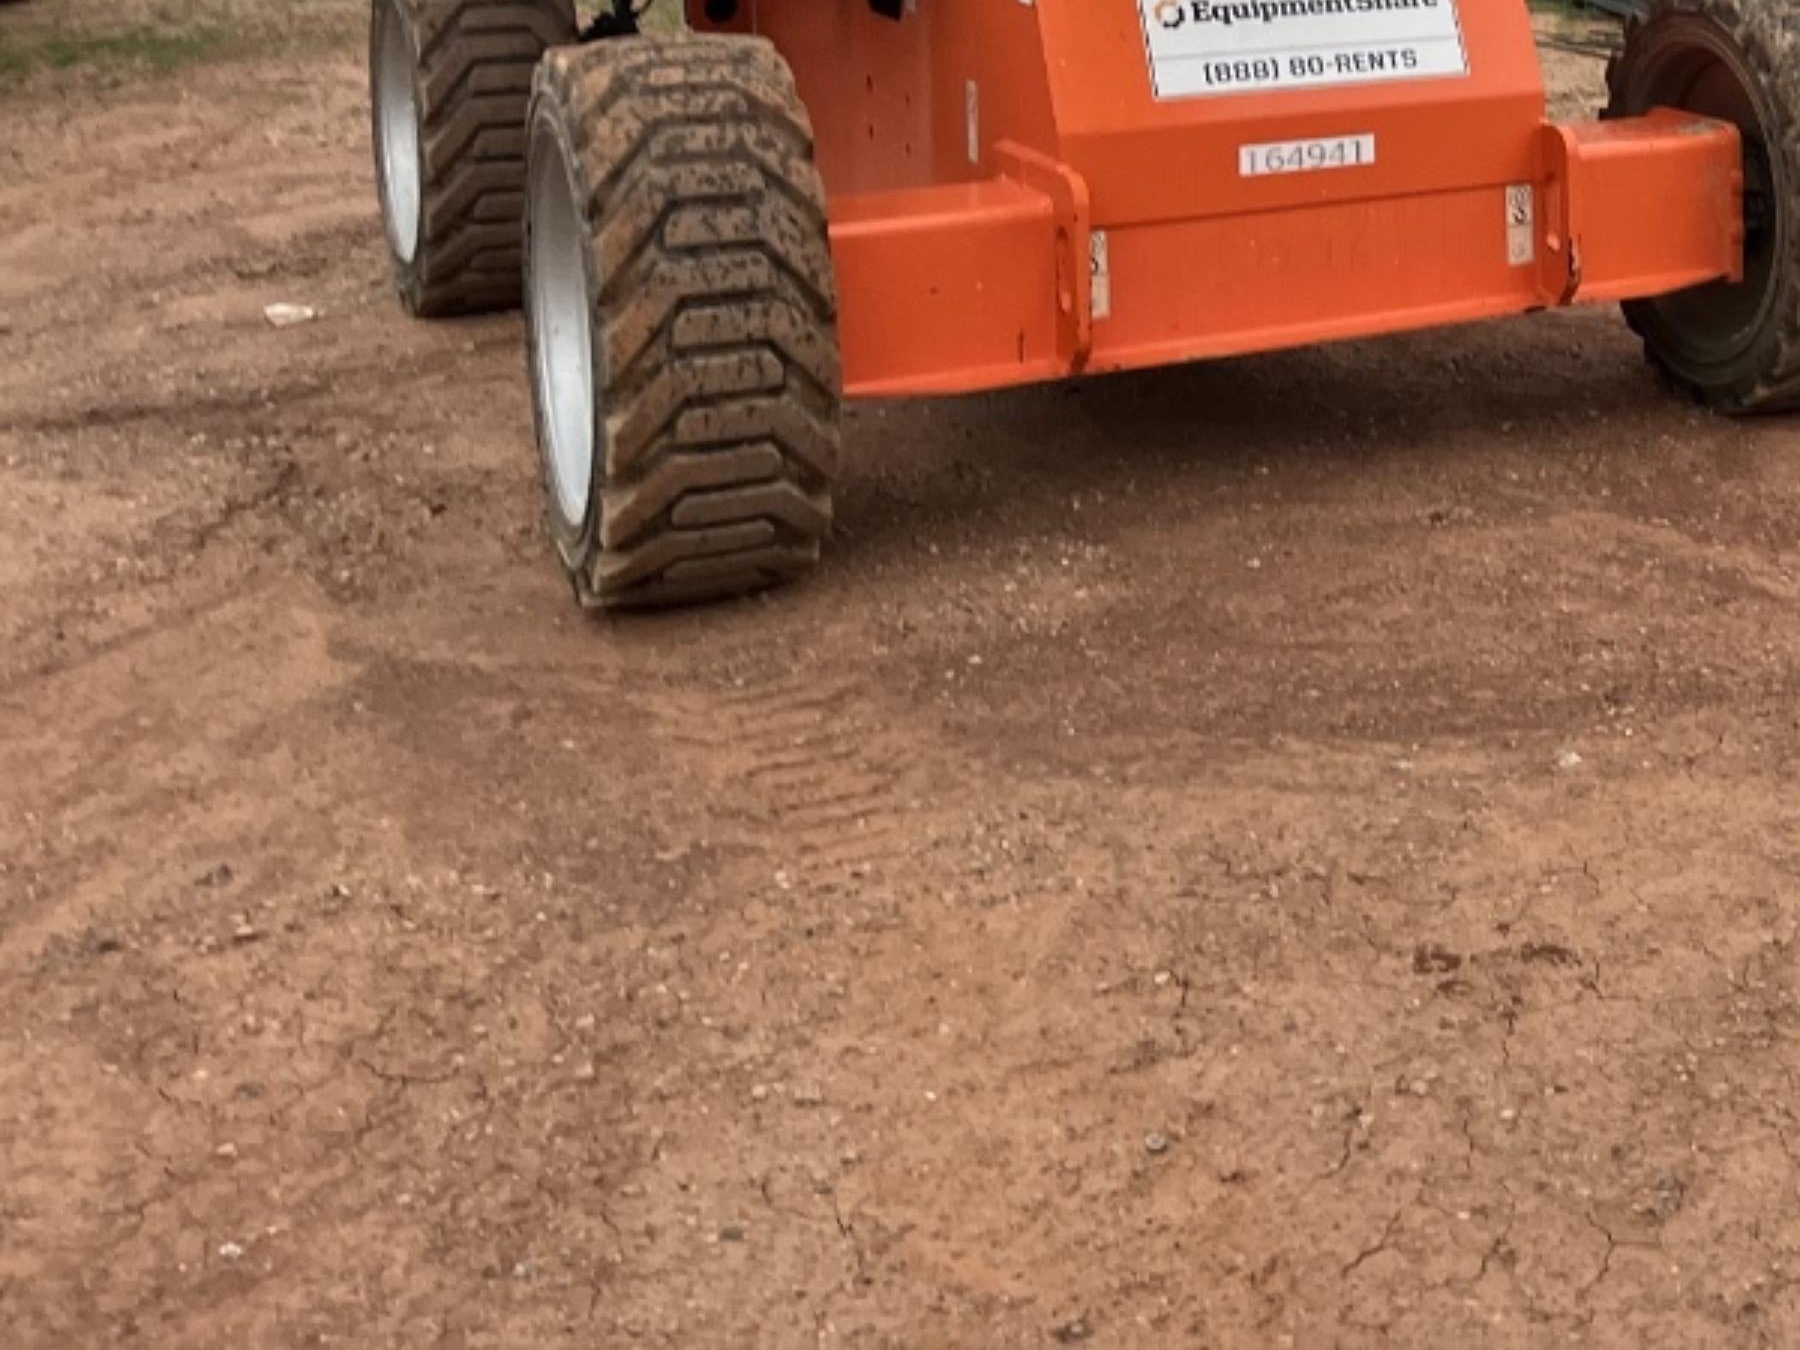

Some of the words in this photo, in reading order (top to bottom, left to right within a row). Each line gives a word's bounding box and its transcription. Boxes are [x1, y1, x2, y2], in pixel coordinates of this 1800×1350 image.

[1203, 55, 1280, 85] (888)
[1289, 48, 1418, 78] 80-RENTS
[1248, 138, 1364, 174] 164941
